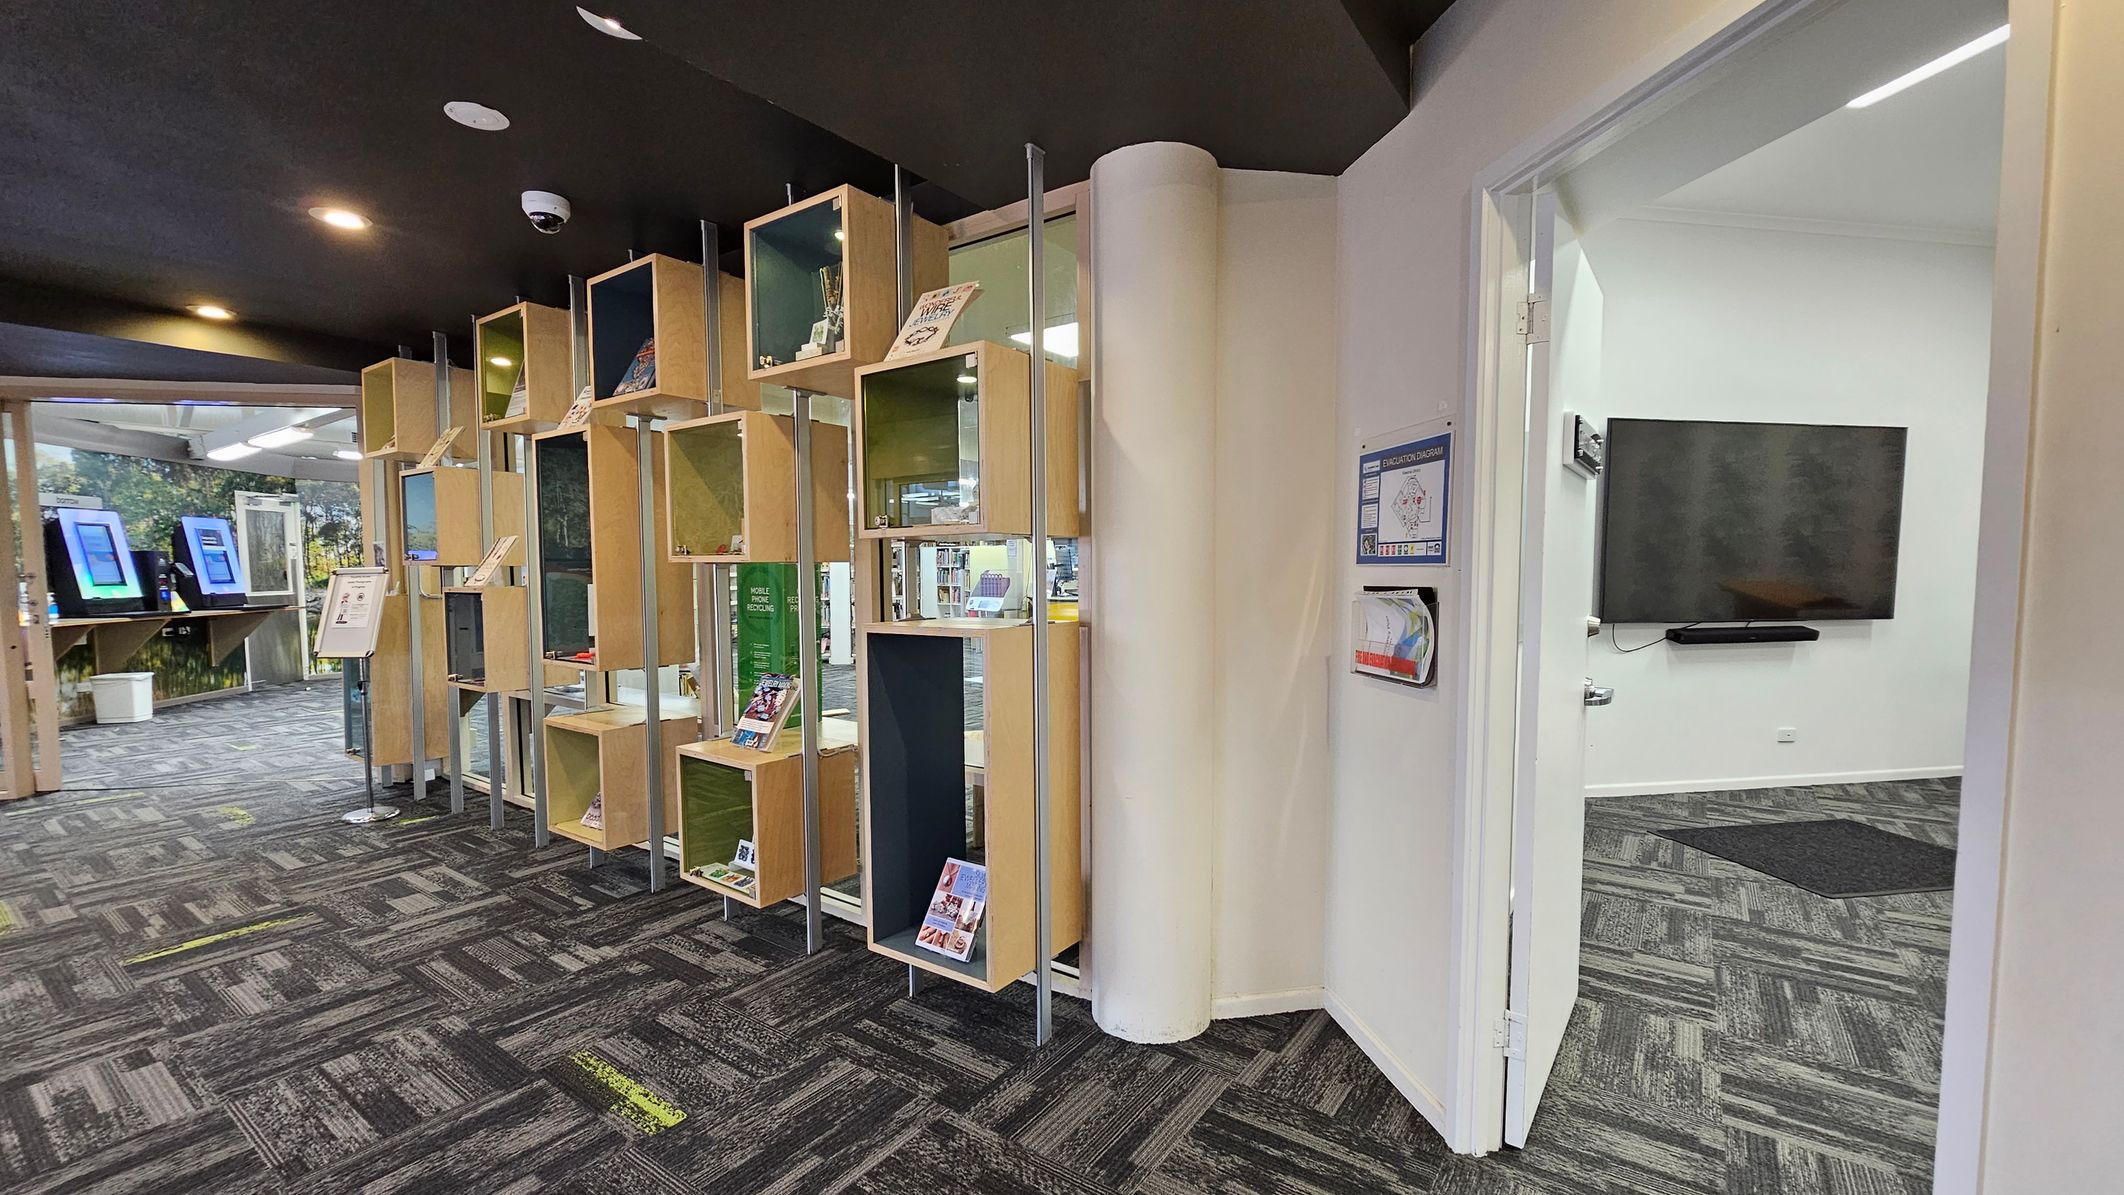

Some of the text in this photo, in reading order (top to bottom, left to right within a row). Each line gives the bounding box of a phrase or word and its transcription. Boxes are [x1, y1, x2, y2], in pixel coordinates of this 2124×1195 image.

[920, 300, 955, 317] WIRE
[1382, 453, 1416, 468] EVACUATION
[1416, 446, 1444, 460] DIAGRAM
[750, 587, 770, 595] MOBILE
[751, 595, 769, 603] PHONE
[747, 603, 775, 612] RECYCLING
